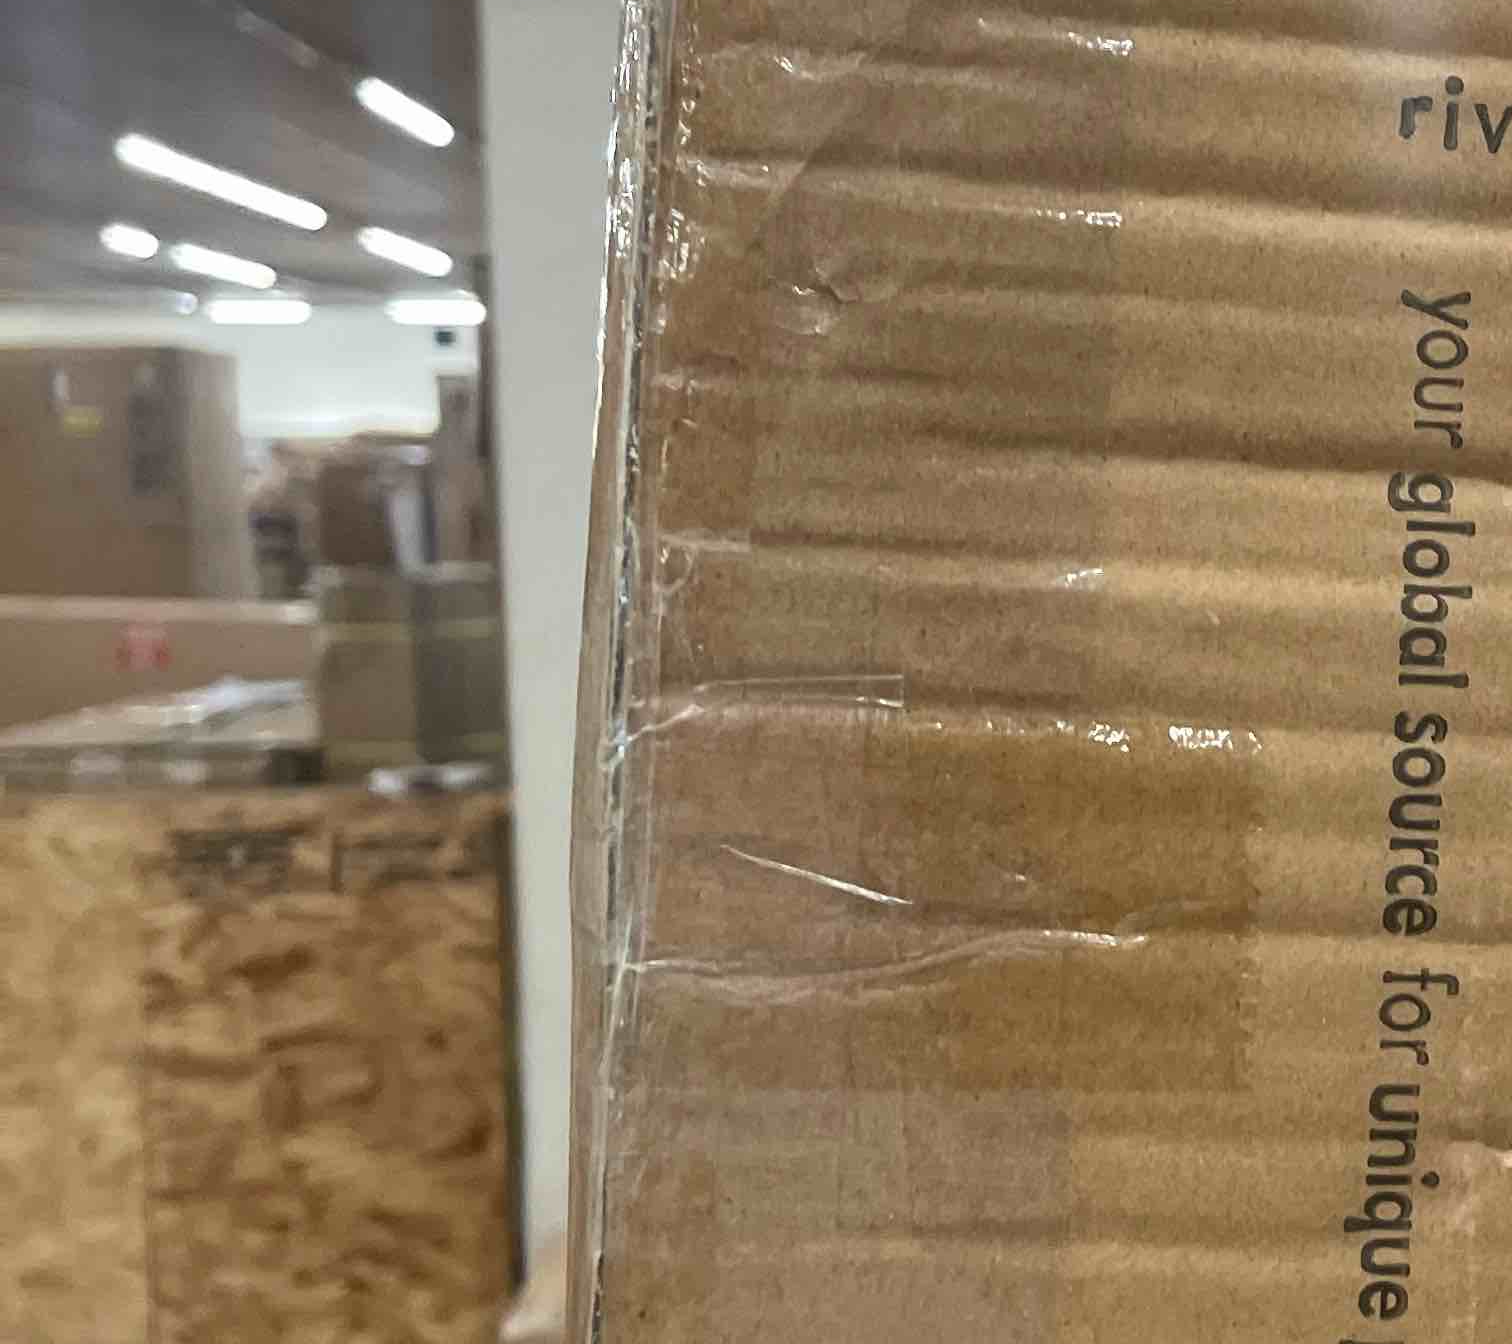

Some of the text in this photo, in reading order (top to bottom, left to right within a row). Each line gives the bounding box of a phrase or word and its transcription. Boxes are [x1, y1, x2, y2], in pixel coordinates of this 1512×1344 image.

[1400, 290, 1471, 450] your
[1387, 472, 1476, 688] global
[1382, 711, 1448, 937] source
[1379, 968, 1460, 1065] for
[1343, 1084, 1440, 1321] unique
